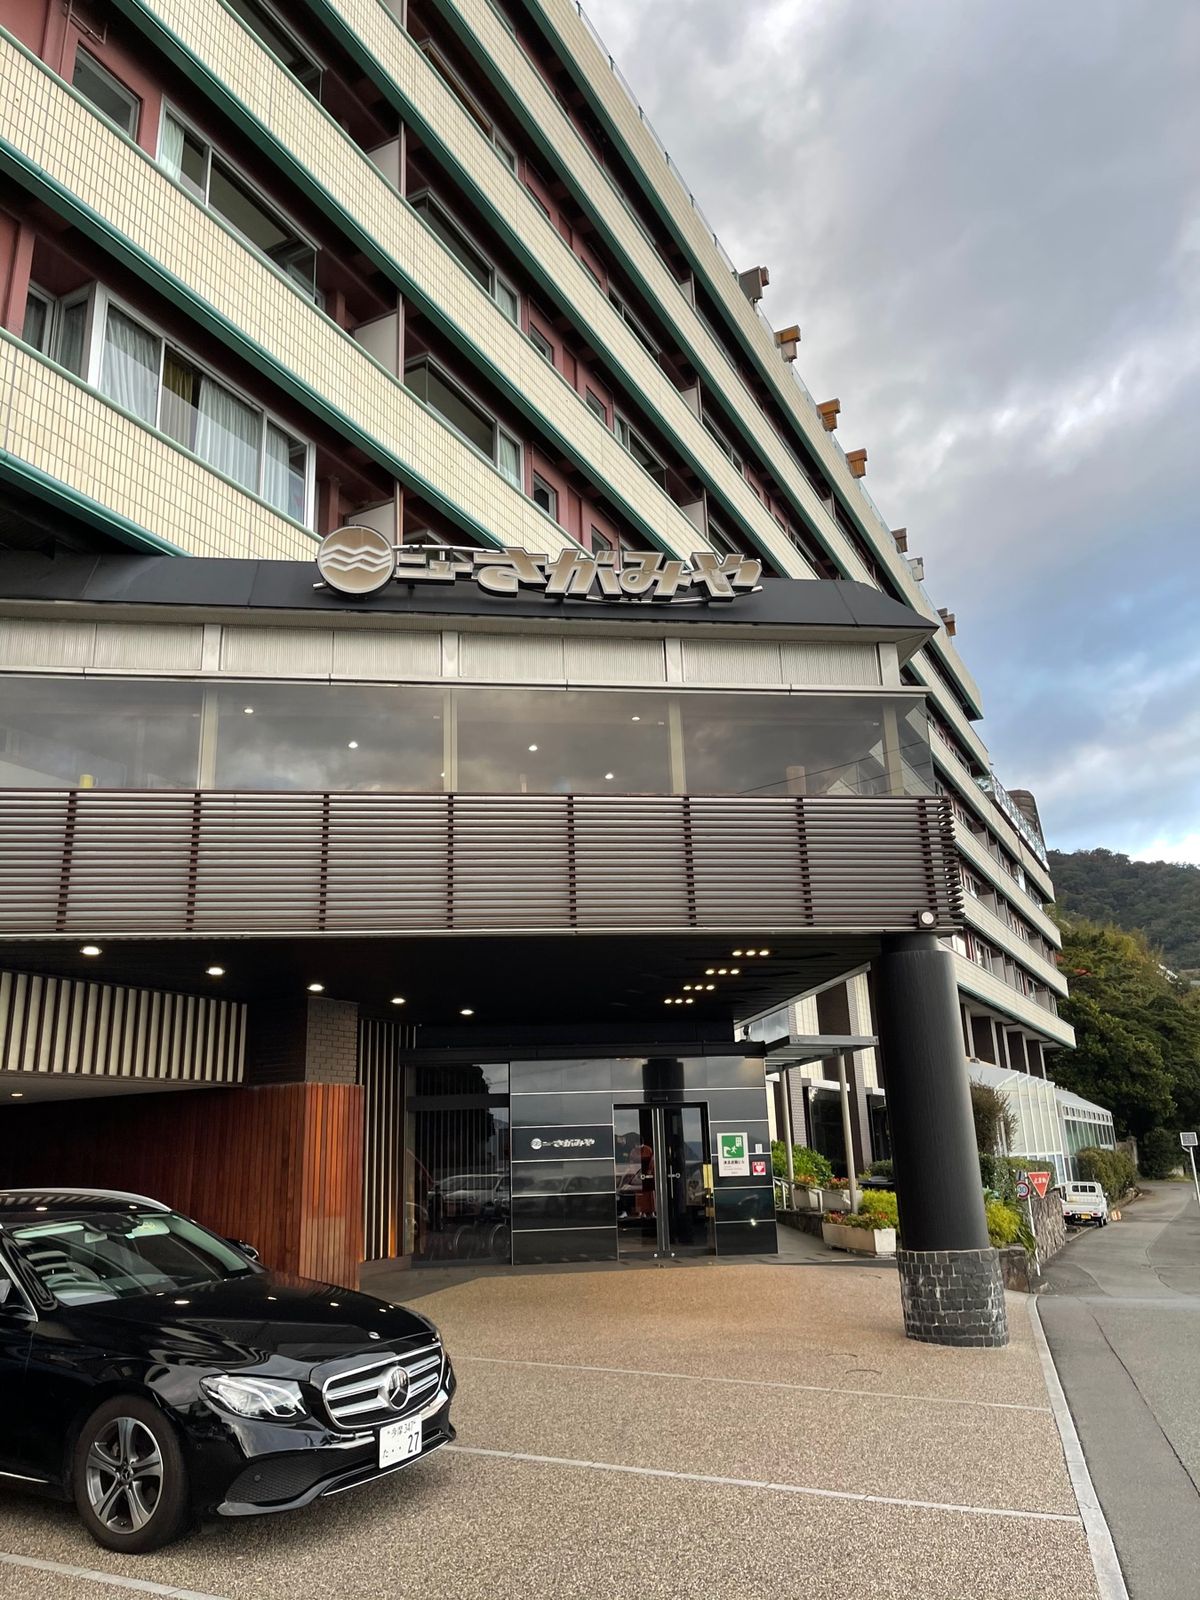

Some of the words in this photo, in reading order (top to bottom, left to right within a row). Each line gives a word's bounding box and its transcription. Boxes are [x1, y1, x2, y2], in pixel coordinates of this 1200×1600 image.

[396, 547, 762, 599] ニューさがみや
